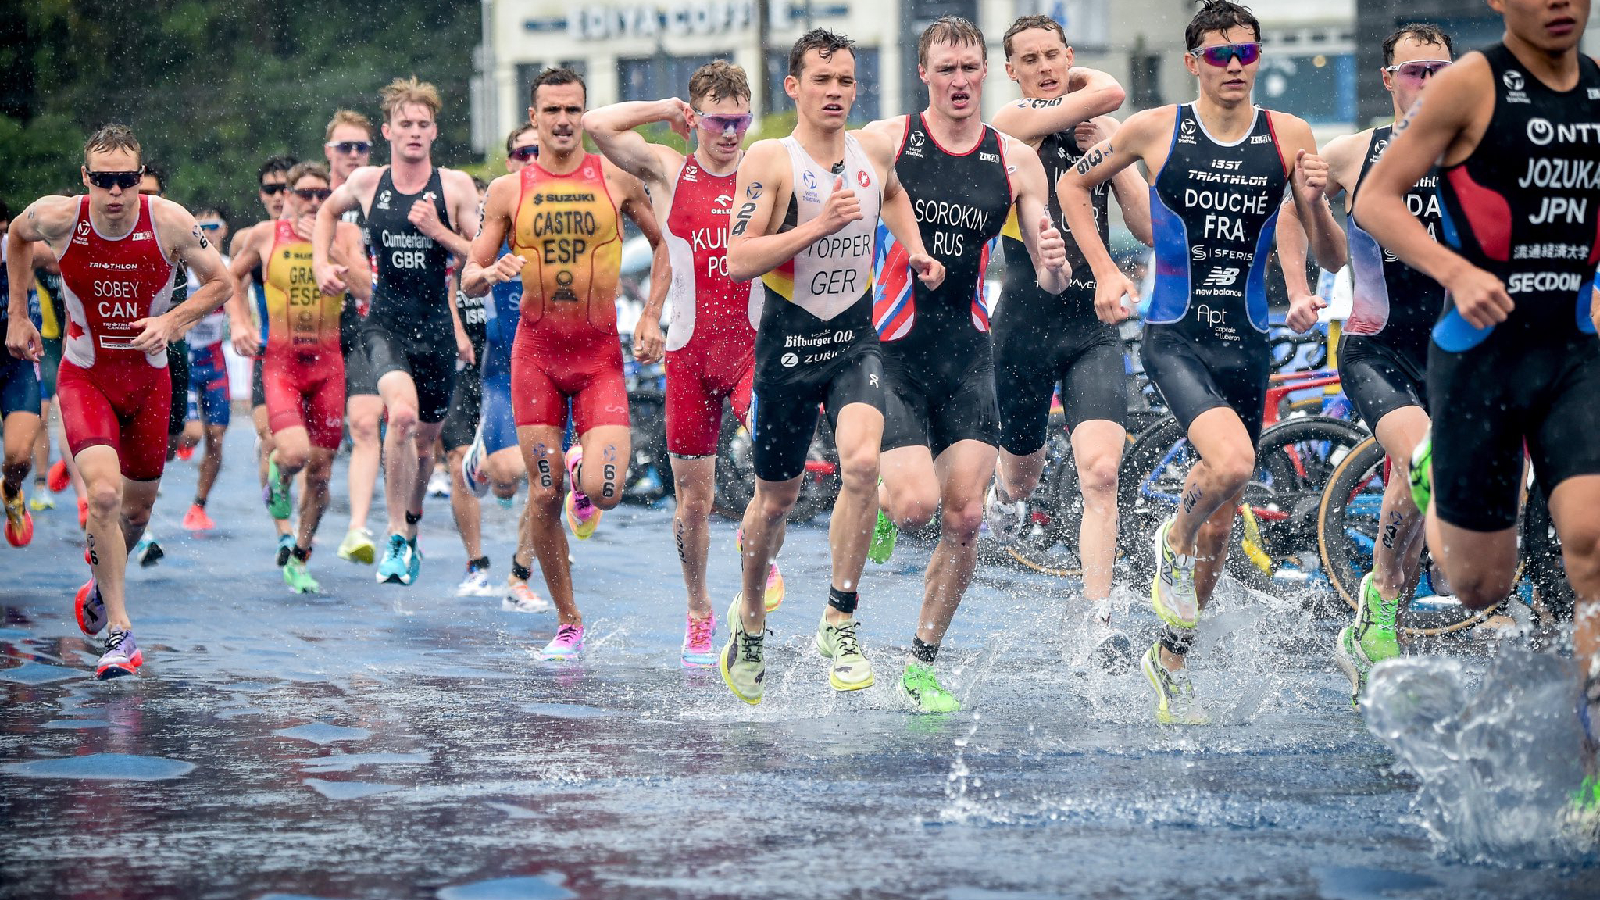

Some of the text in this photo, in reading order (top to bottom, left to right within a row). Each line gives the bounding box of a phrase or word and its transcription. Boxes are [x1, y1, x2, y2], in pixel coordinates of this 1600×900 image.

[1211, 159, 1243, 171] ISSY
[1188, 169, 1269, 187] TRIATHLON
[545, 193, 596, 204] SUZUKI
[1184, 188, 1269, 215] DOUCHÉ
[1528, 196, 1588, 225] JPN
[533, 211, 596, 237] CASTRO
[915, 198, 989, 232] SOROKIN
[1204, 214, 1246, 243] FRA
[543, 239, 586, 264] ESP
[933, 230, 964, 257] RUS
[391, 250, 427, 270] GBR
[93, 280, 140, 299] SOBEY
[810, 268, 857, 296] GER
[1195, 287, 1243, 298] new balance
[97, 302, 138, 318] CAN
[1197, 304, 1228, 328] Apt
[602, 464, 616, 498] 66
